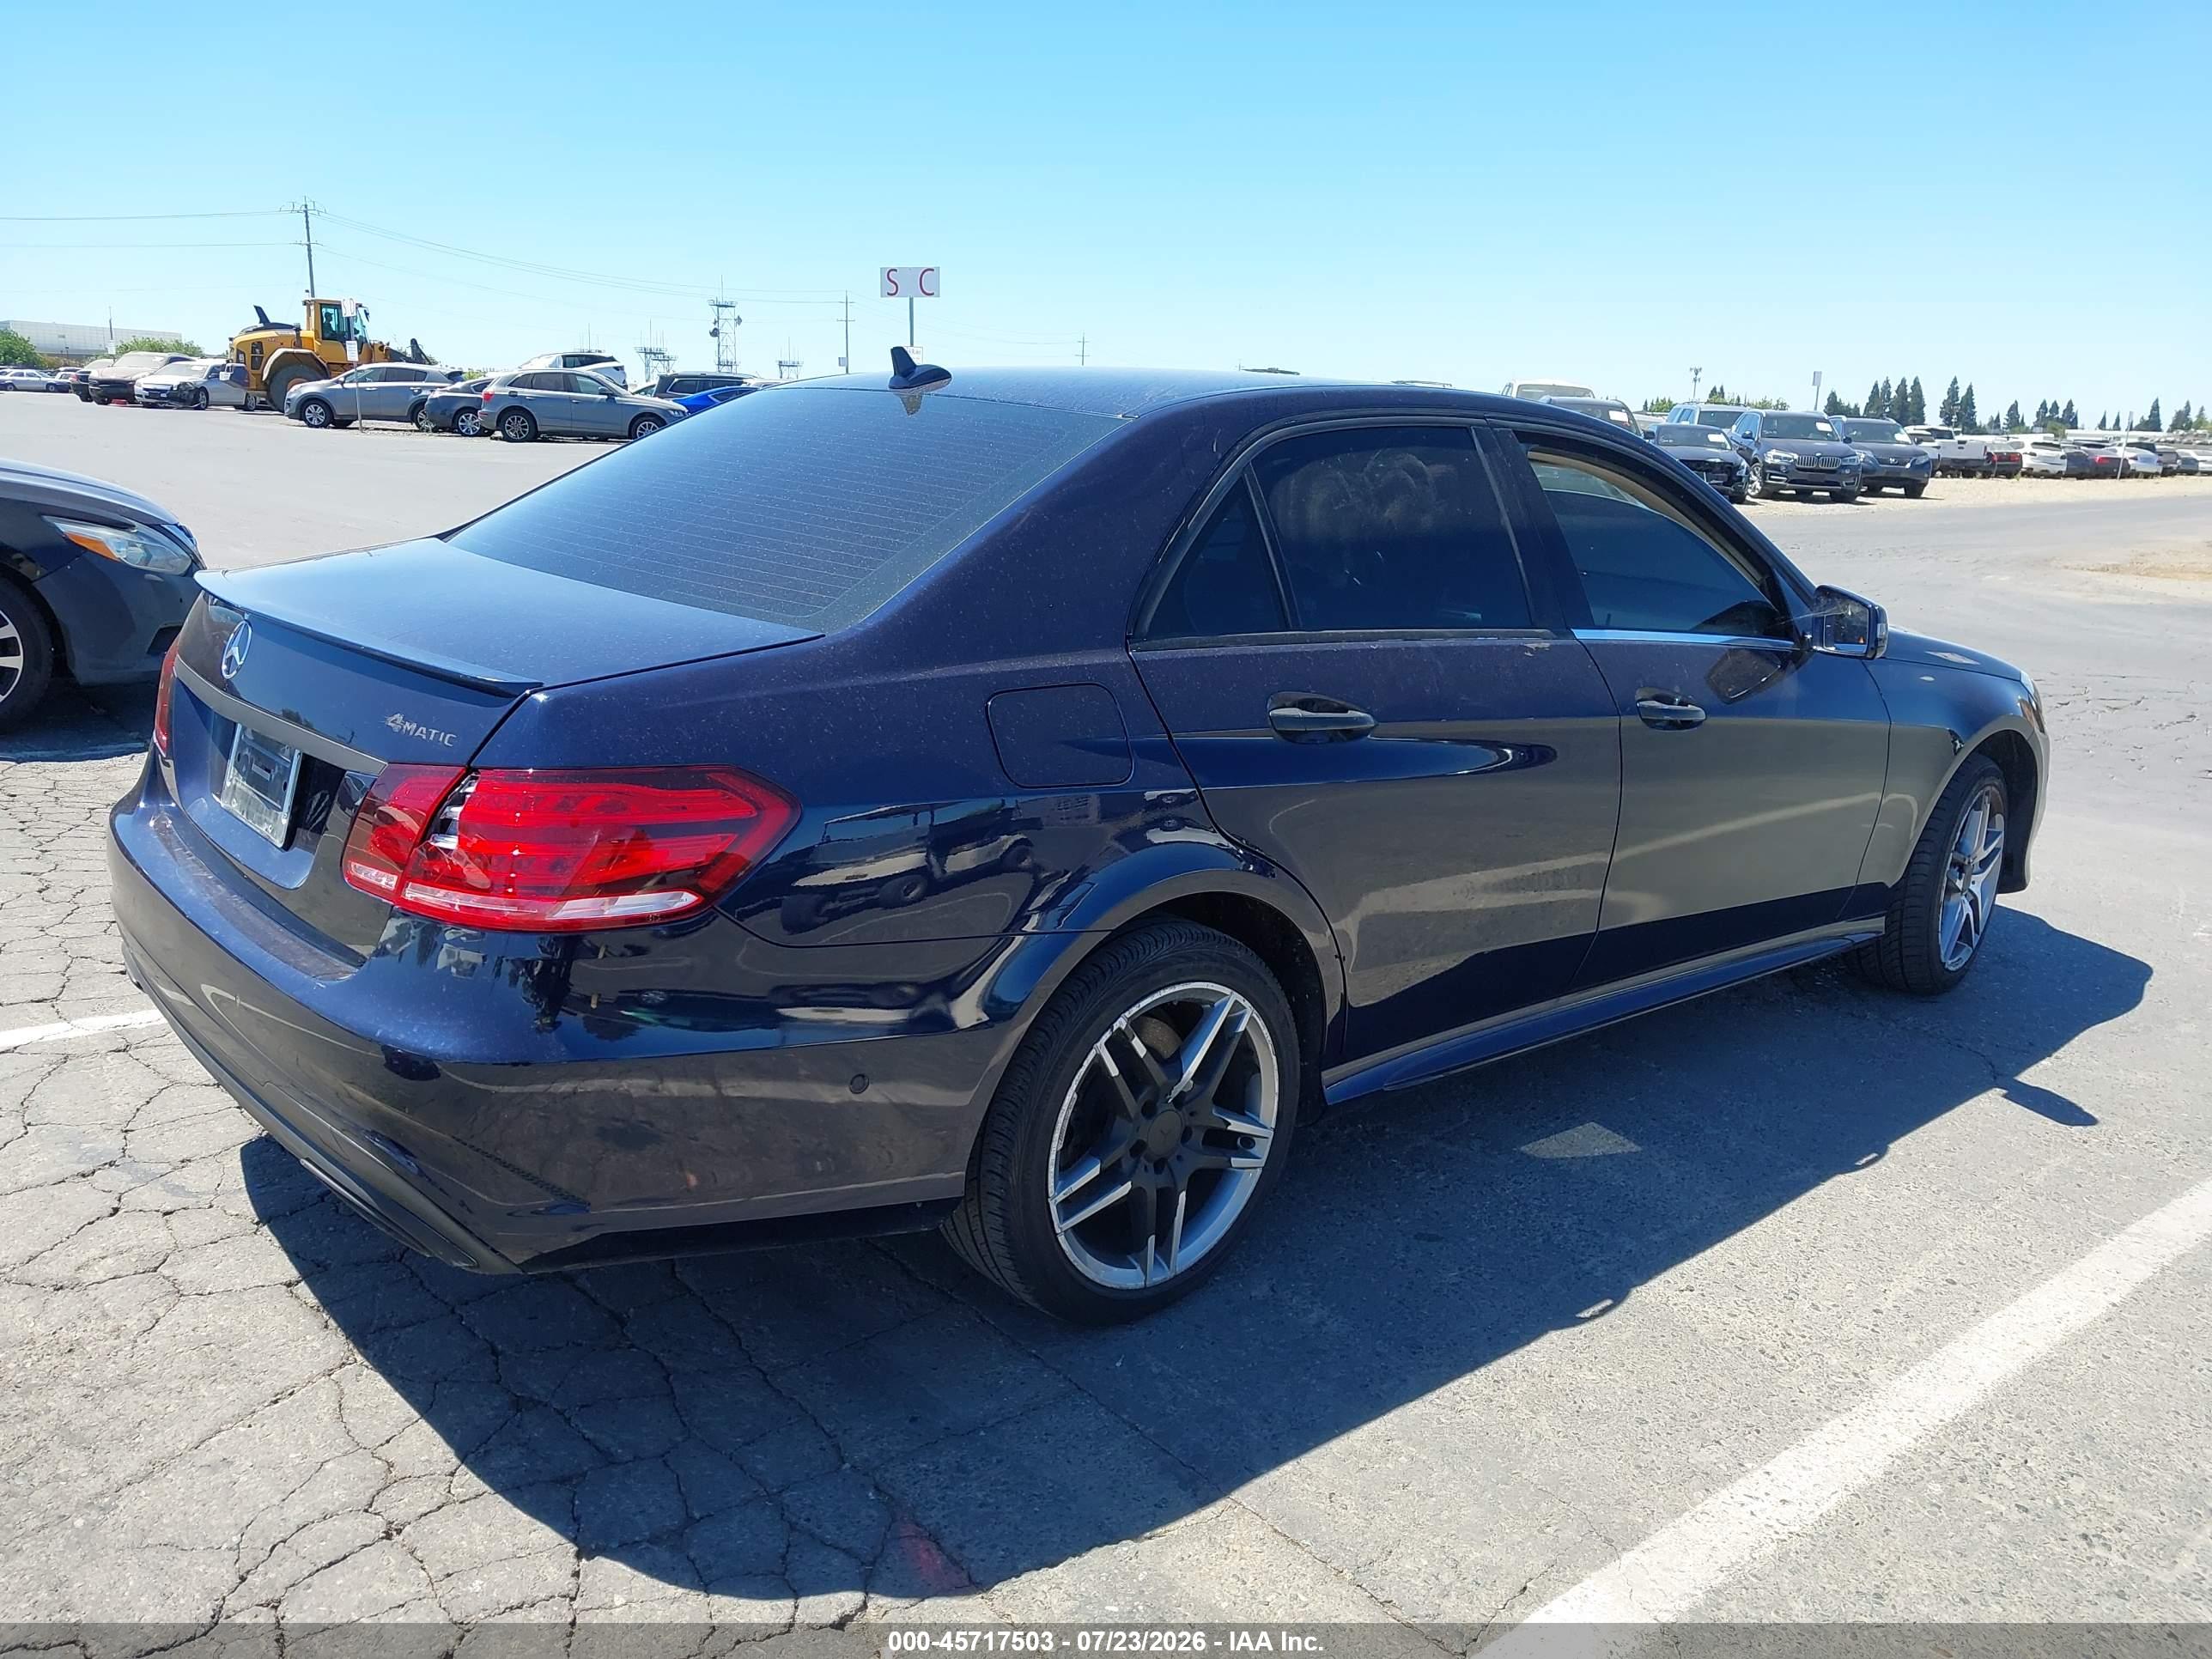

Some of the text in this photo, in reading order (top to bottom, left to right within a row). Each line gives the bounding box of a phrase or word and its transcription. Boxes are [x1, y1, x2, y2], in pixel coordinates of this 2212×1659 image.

[886, 268, 935, 296] S C
[385, 713, 457, 747] 4MATIC
